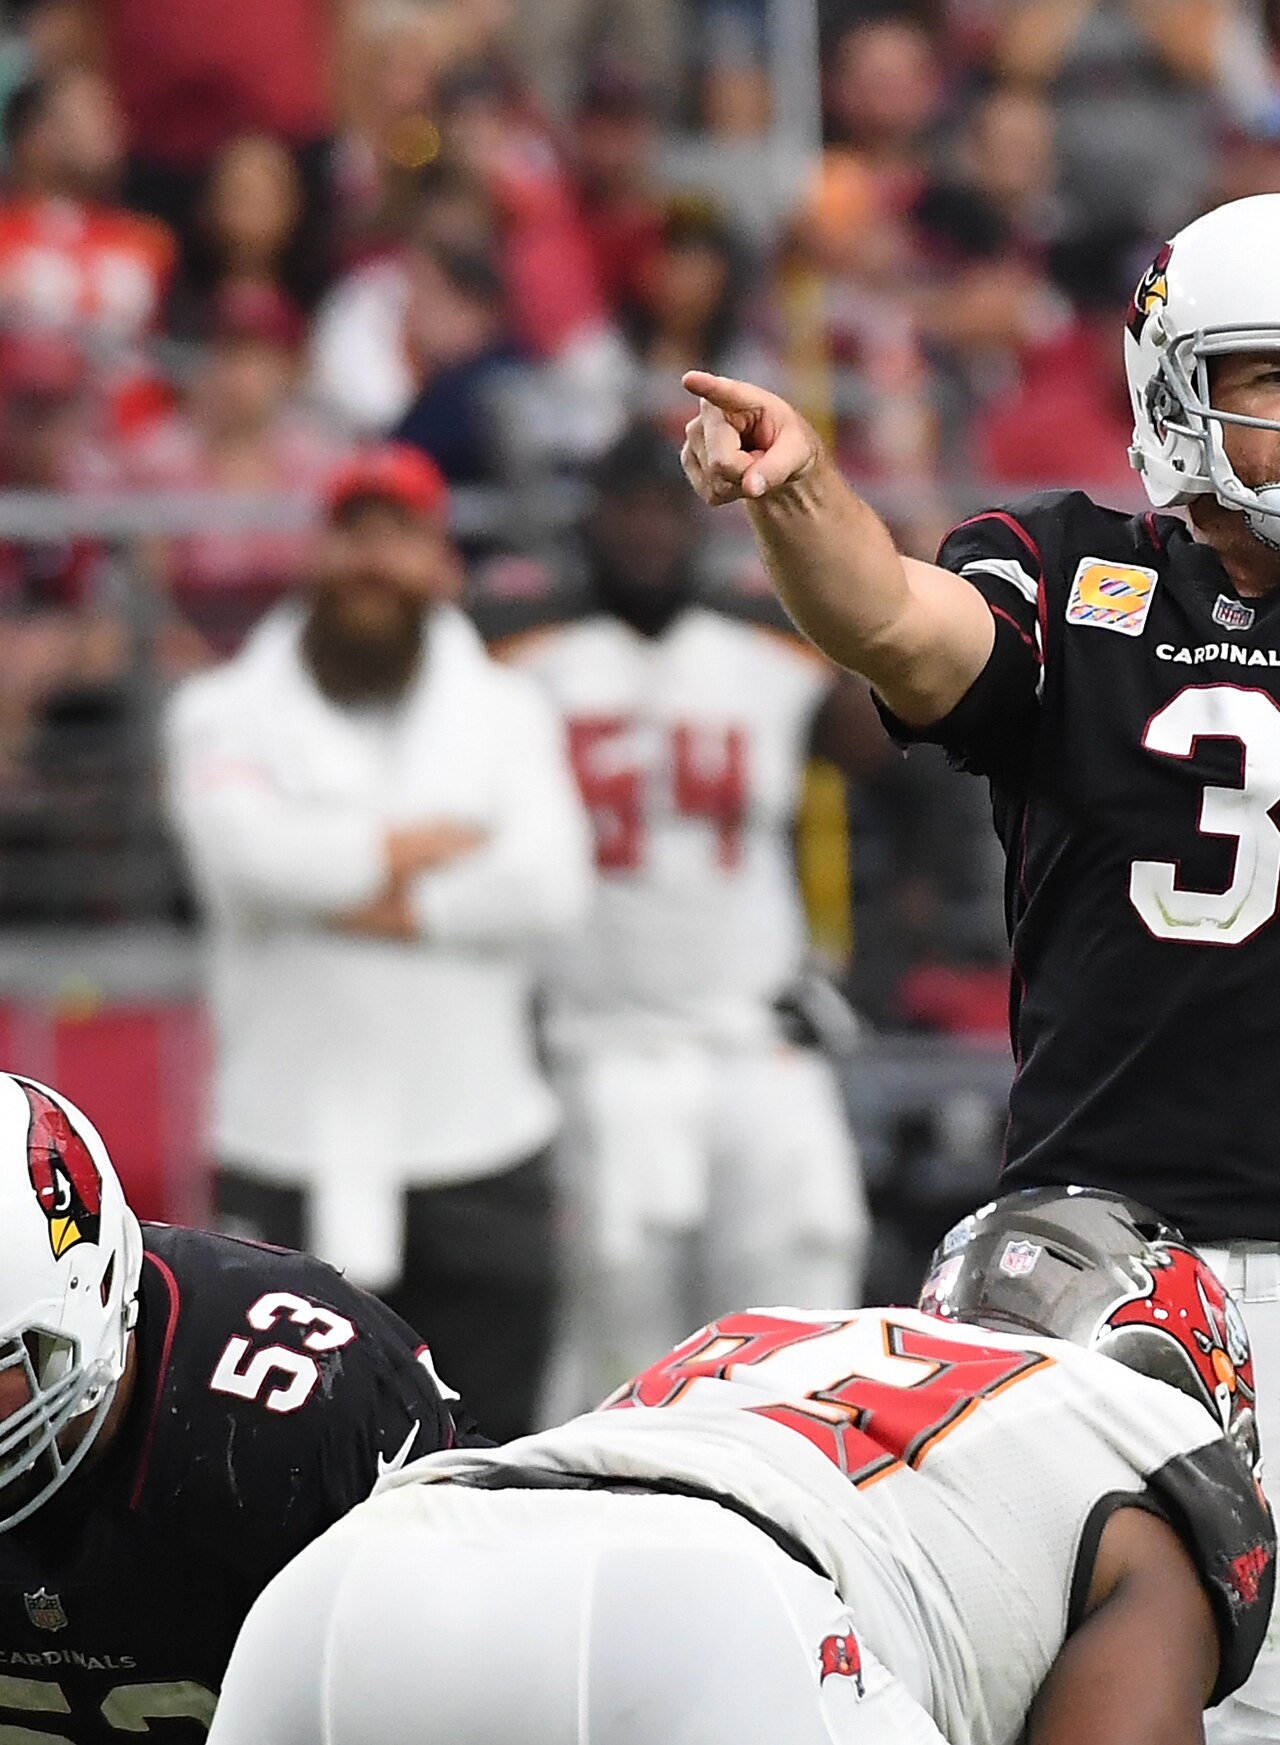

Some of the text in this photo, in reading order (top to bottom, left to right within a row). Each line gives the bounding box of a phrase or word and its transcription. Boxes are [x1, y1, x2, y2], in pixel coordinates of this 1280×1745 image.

[1218, 606, 1249, 625] NFL
[568, 715, 742, 872] 54
[209, 1291, 358, 1413] 53
